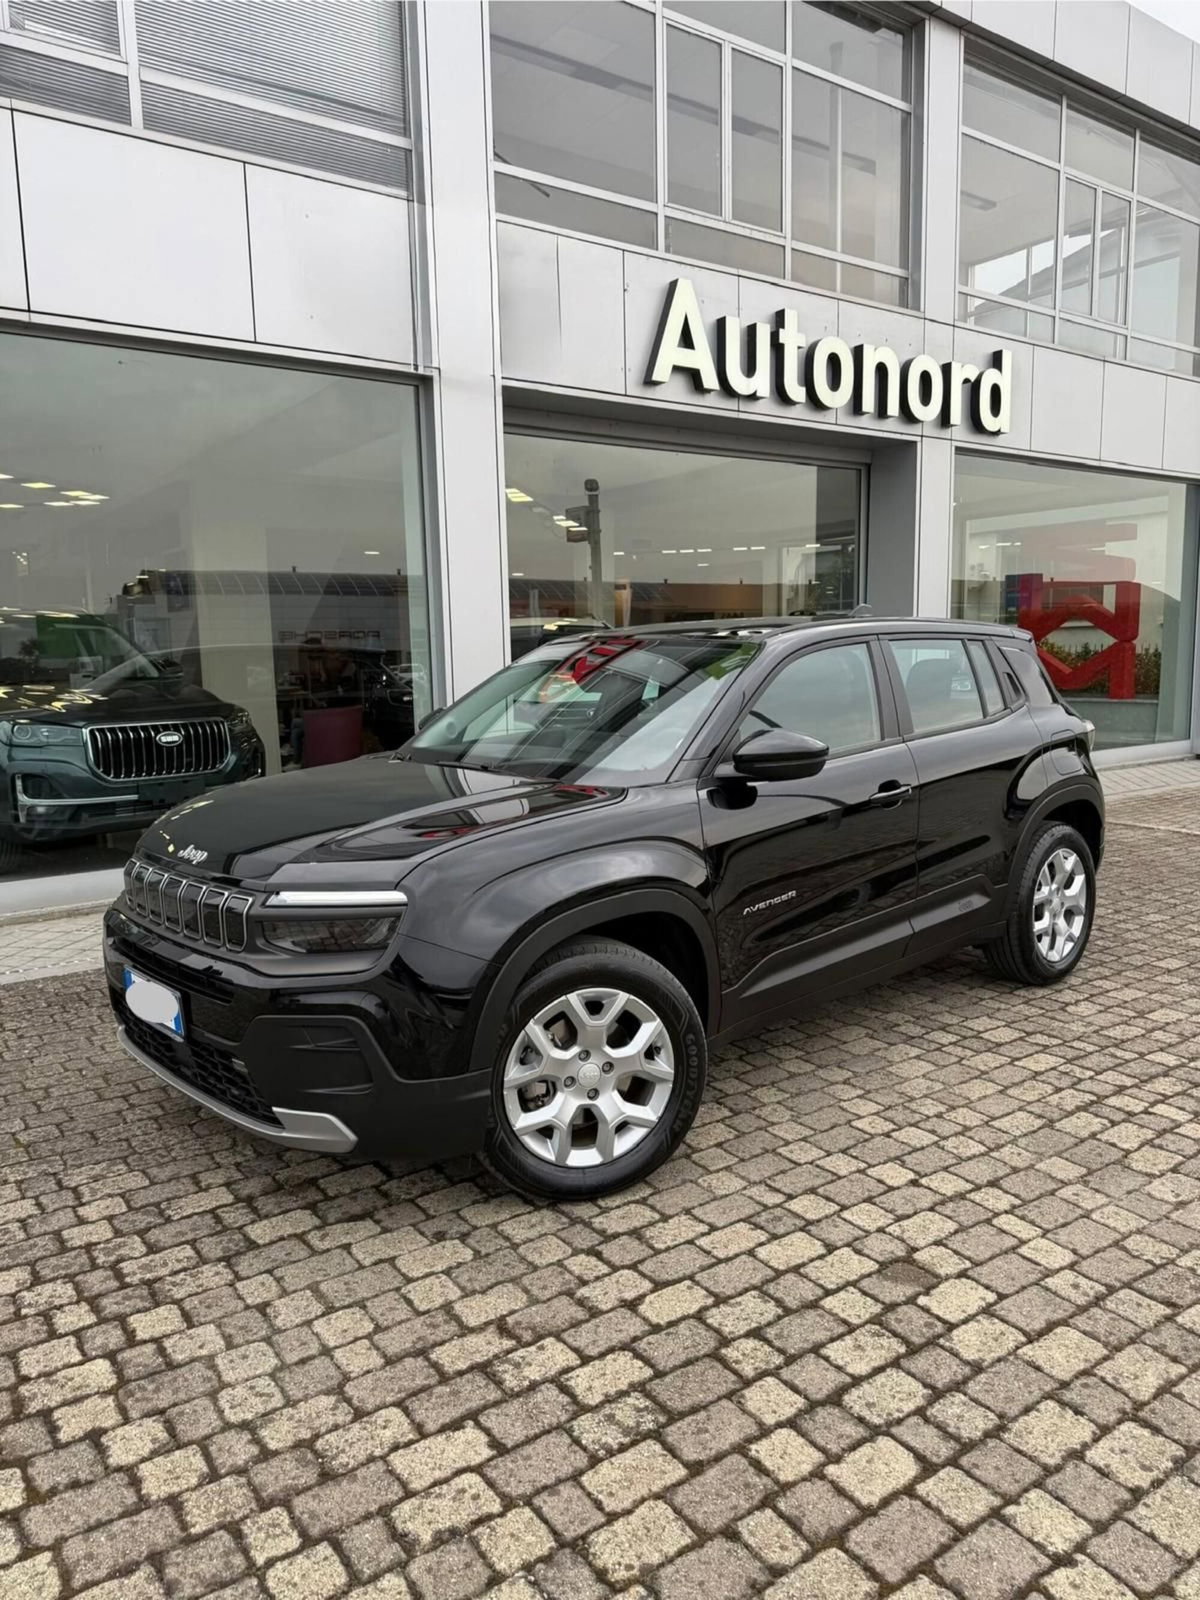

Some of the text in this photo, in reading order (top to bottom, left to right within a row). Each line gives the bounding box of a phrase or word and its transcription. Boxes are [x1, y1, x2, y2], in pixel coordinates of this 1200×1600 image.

[646, 278, 1012, 434] Autonord
[177, 844, 208, 865] Jeep
[743, 890, 797, 916] AVENGER
